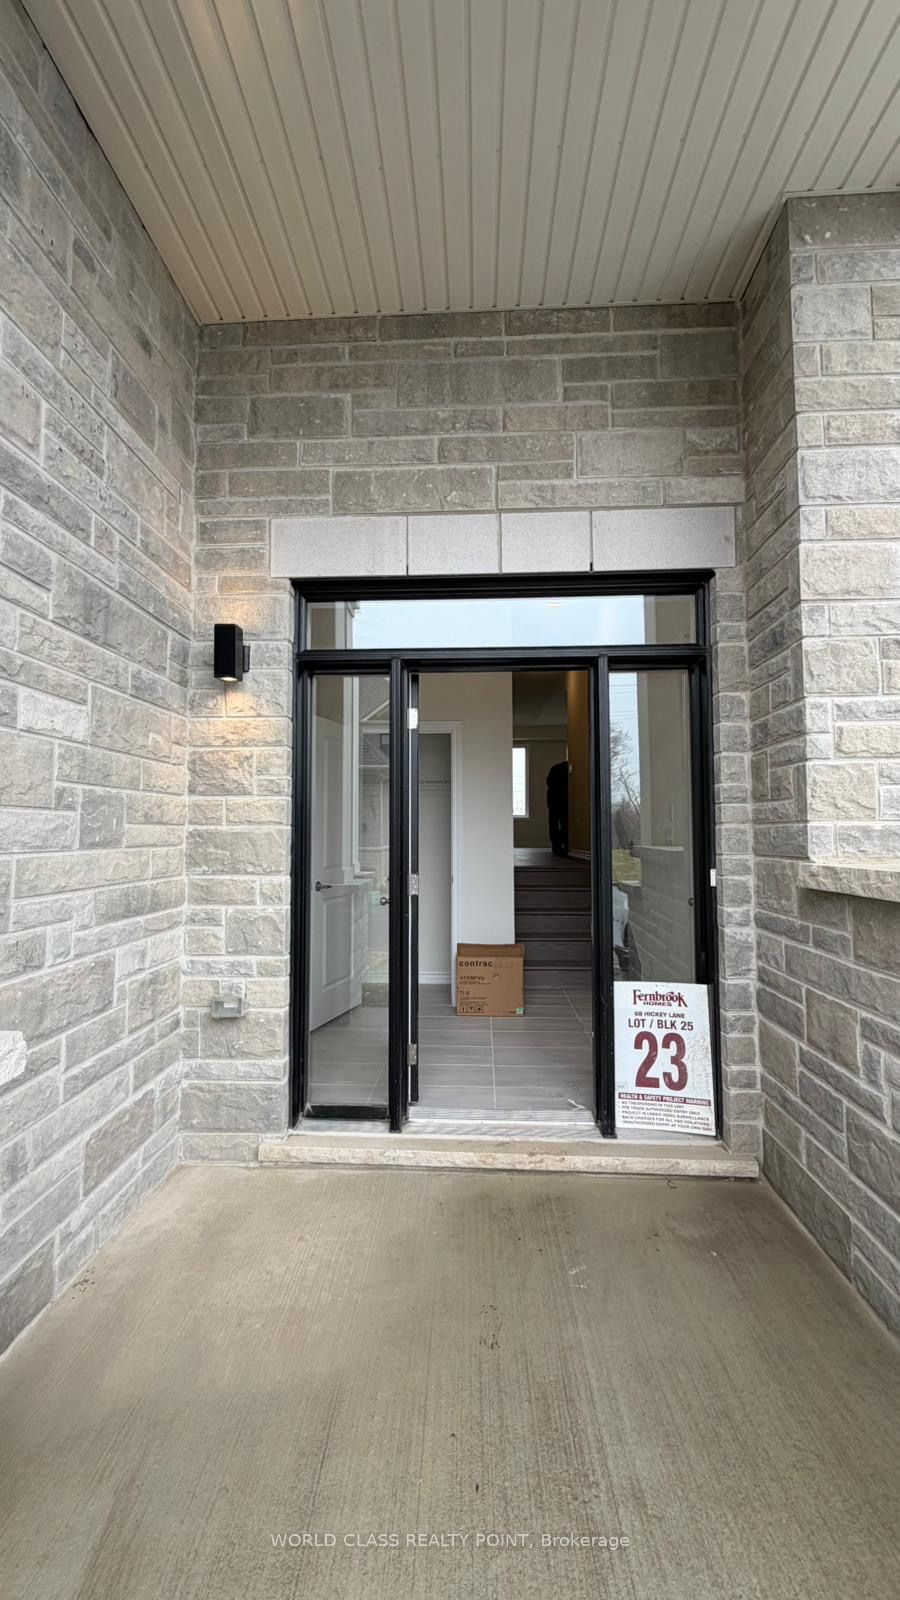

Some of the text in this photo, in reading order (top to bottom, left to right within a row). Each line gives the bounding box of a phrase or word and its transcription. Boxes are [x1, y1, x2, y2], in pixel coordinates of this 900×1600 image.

[628, 1018, 694, 1031] LOT / BLK 25
[634, 1031, 688, 1091] 23
